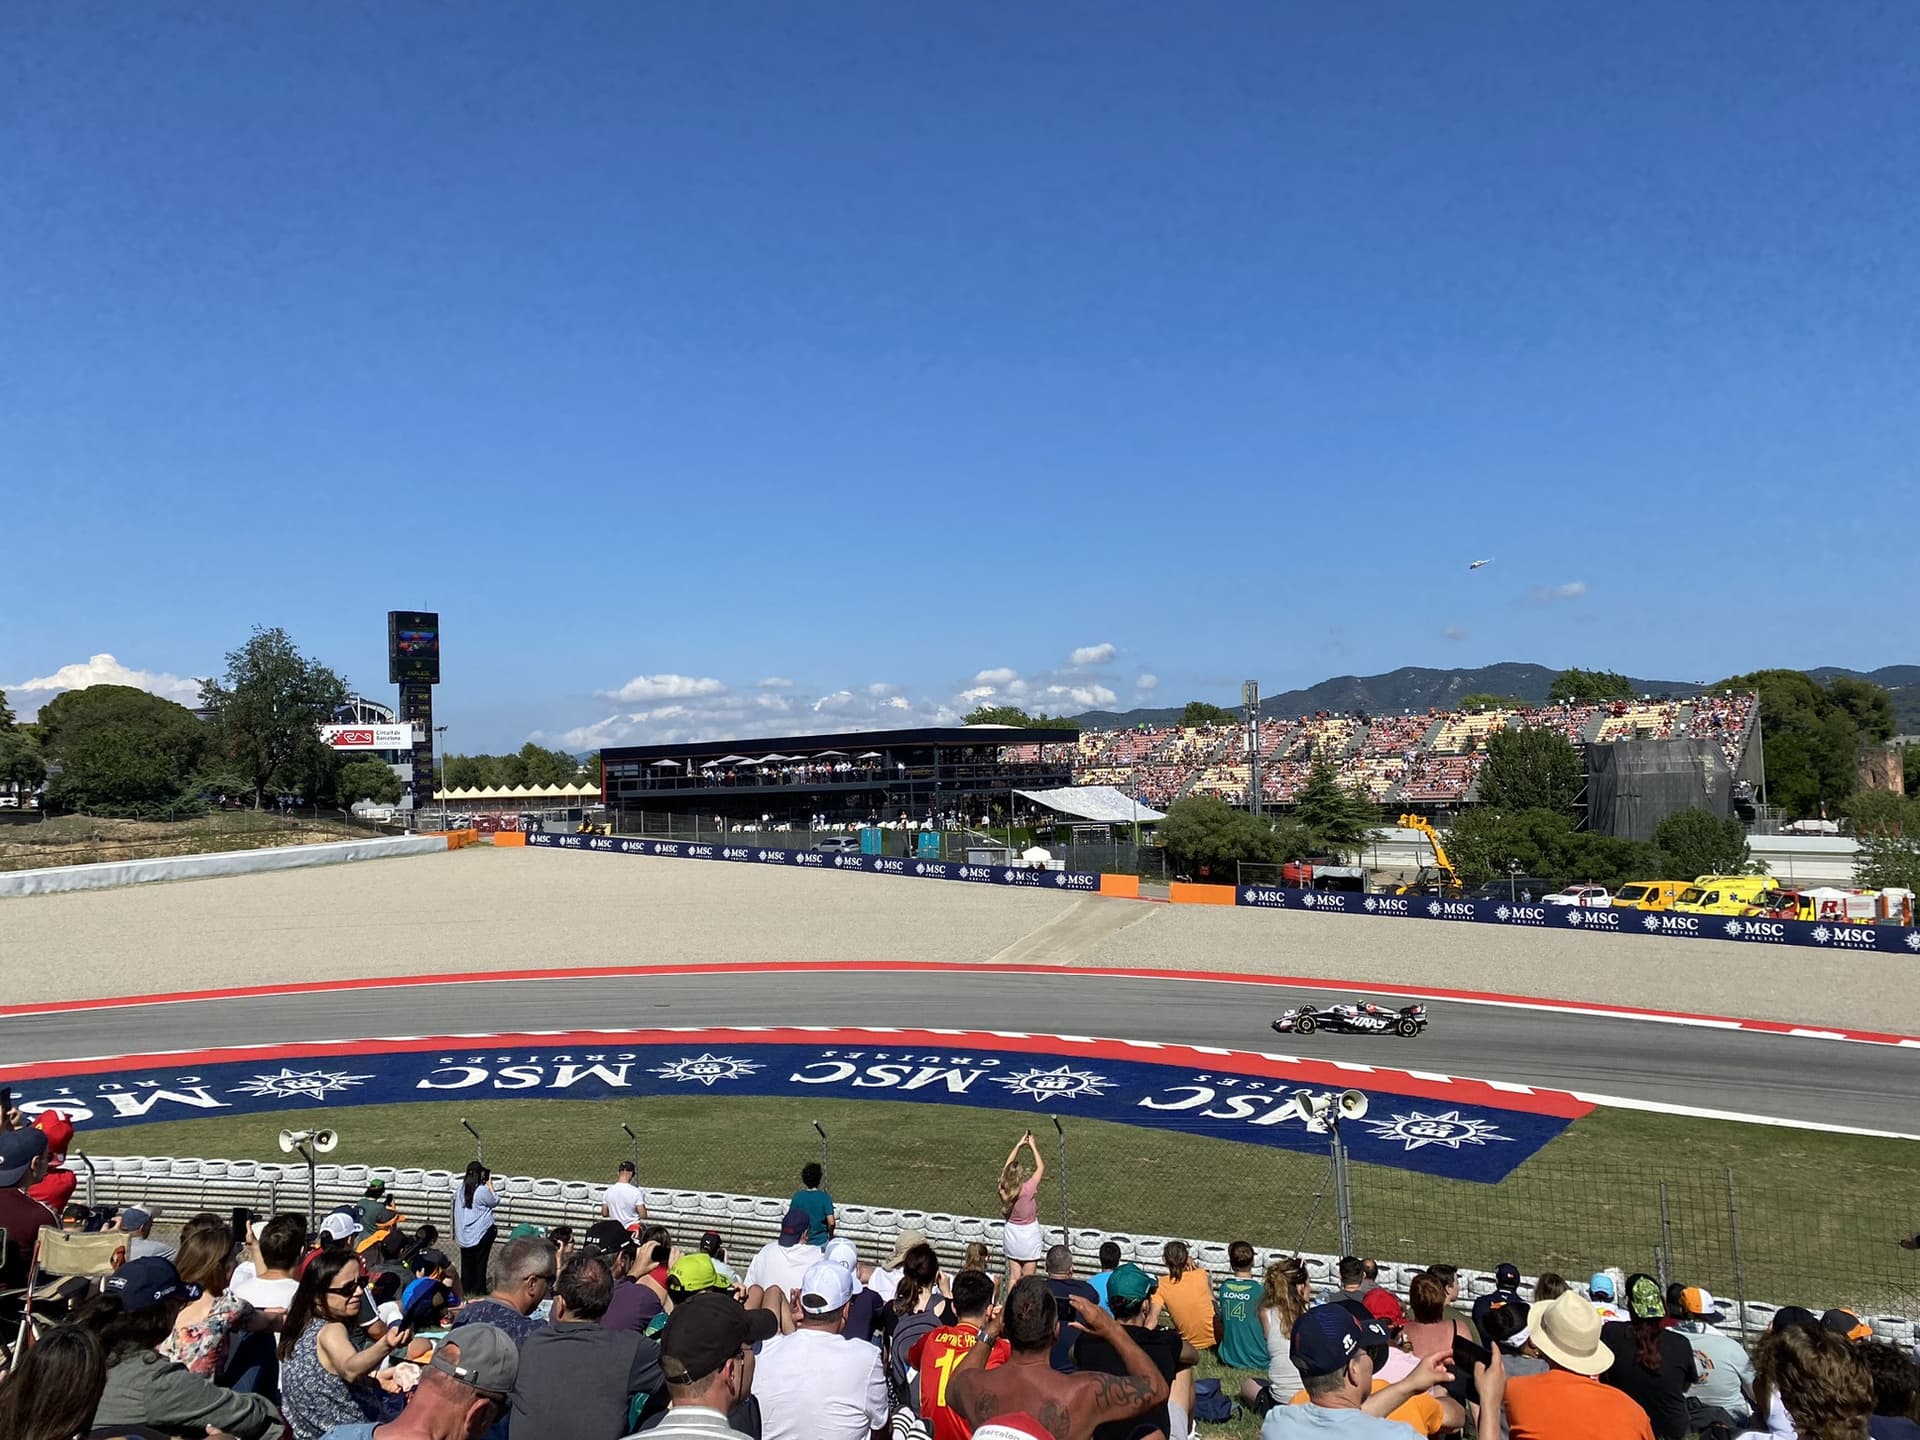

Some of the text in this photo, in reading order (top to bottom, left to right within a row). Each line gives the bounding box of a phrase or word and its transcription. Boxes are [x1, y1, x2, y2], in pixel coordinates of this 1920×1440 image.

[598, 839, 612, 847] MSC
[662, 844, 678, 852] MSC
[731, 849, 748, 857] MSC
[767, 851, 784, 860] MSC
[805, 854, 823, 862] MSC
[844, 857, 862, 866] MSC
[884, 861, 903, 870] MSC
[926, 865, 946, 874] MSC
[969, 868, 990, 877] MSC
[1016, 872, 1039, 881] MSC
[1068, 875, 1093, 884] MSC
[1258, 891, 1285, 901] MSC
[1317, 895, 1344, 905] MSC
[1379, 898, 1408, 910] MSC
[1444, 903, 1474, 914] MSC
[1820, 900, 1838, 913] R
[1512, 907, 1544, 919] MSC
[1585, 912, 1619, 924] MSC
[1662, 916, 1698, 929] MSC
[1745, 922, 1784, 936] MSC
[1834, 928, 1875, 942] MSC
[440, 1053, 636, 1063] CRUISES
[822, 1050, 1000, 1065] CRUISES
[416, 1063, 636, 1089] MSC
[789, 1061, 990, 1093] MSC
[1224, 1300, 1246, 1321] 14
[935, 1349, 968, 1407] 1
